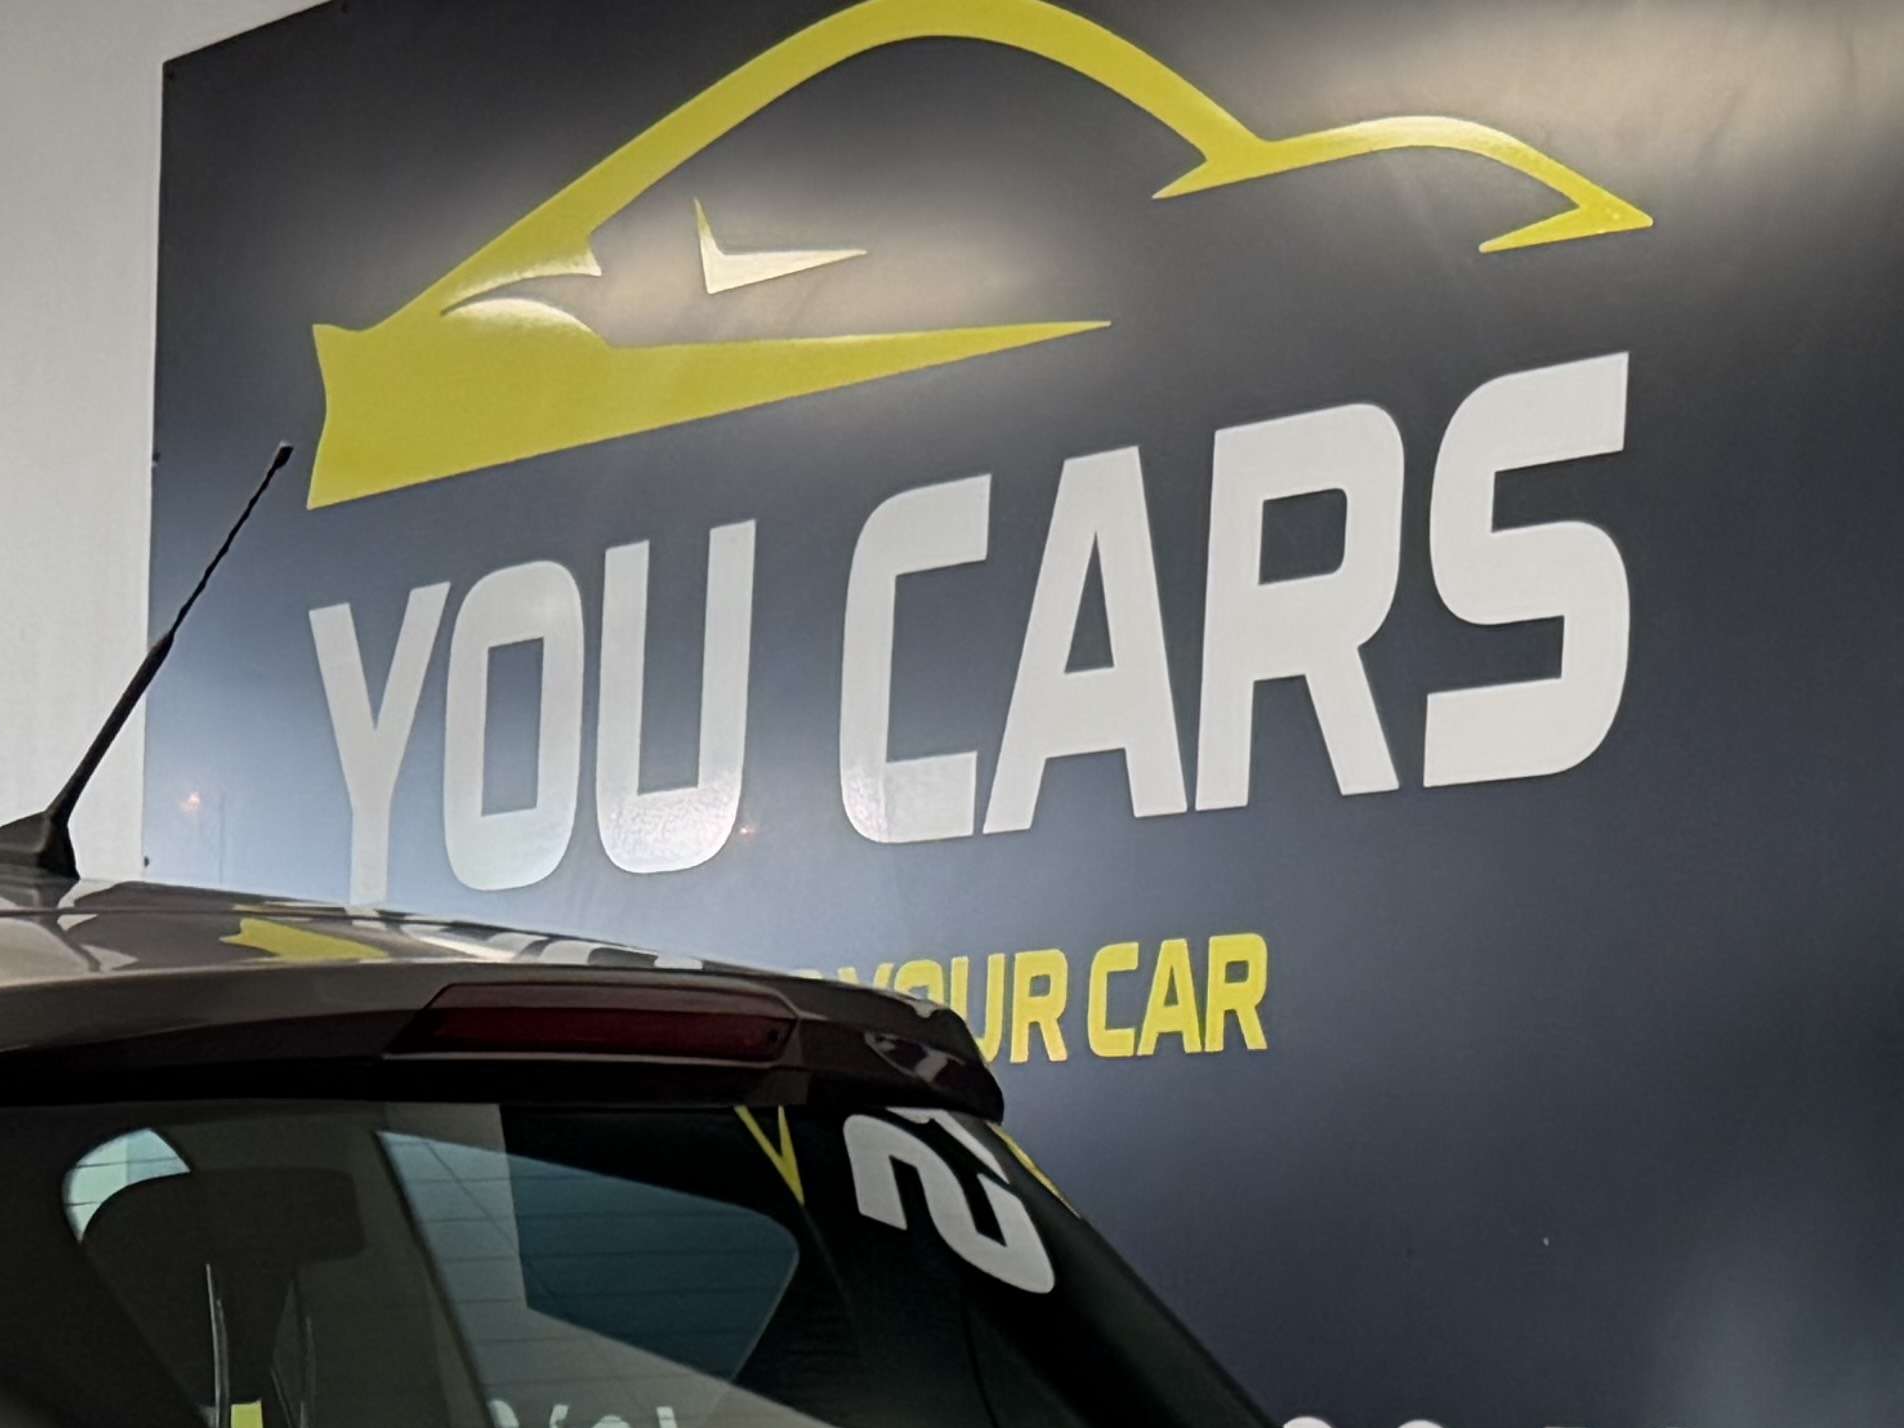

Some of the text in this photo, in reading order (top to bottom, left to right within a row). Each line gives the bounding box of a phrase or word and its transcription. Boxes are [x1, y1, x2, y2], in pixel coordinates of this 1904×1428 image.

[307, 352, 1630, 903] YOU CARS
[837, 932, 1269, 1064] UR CAR
